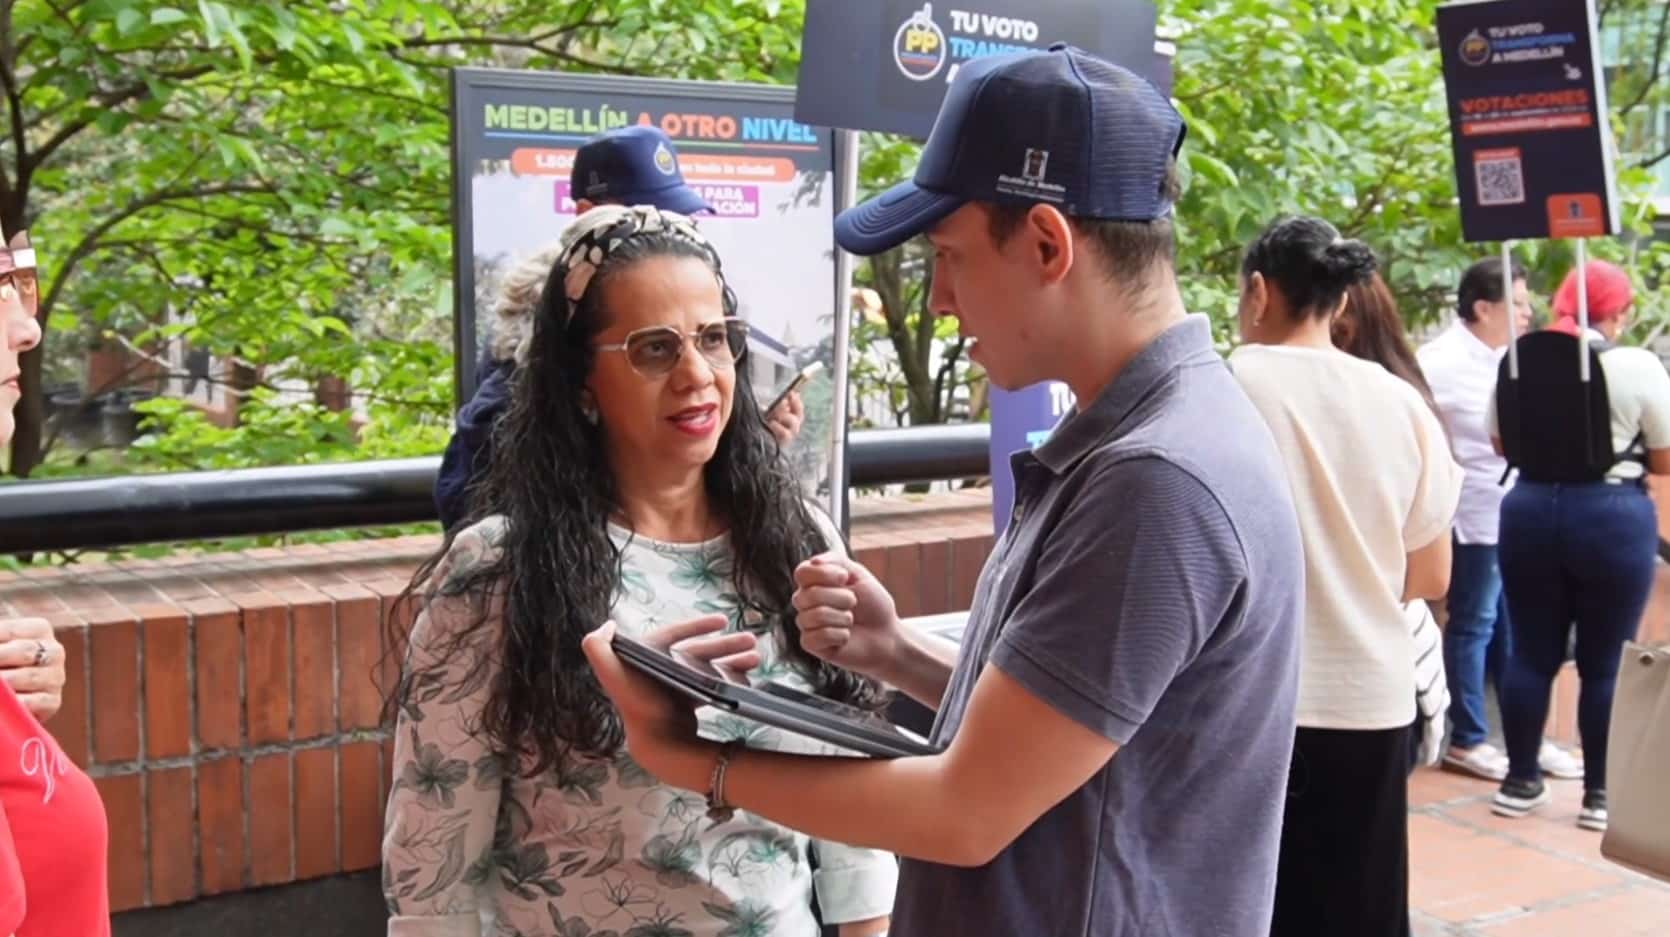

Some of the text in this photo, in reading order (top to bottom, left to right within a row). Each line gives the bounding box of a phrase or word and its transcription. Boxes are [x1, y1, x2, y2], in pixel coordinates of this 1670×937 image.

[950, 10, 1039, 42] TU VOTO
[906, 29, 938, 53] PP
[1461, 88, 1588, 113] VOTACIONES
[484, 103, 628, 133] MEDELLÍN
[661, 113, 737, 139] OTRO
[742, 117, 818, 142] NIVEL
